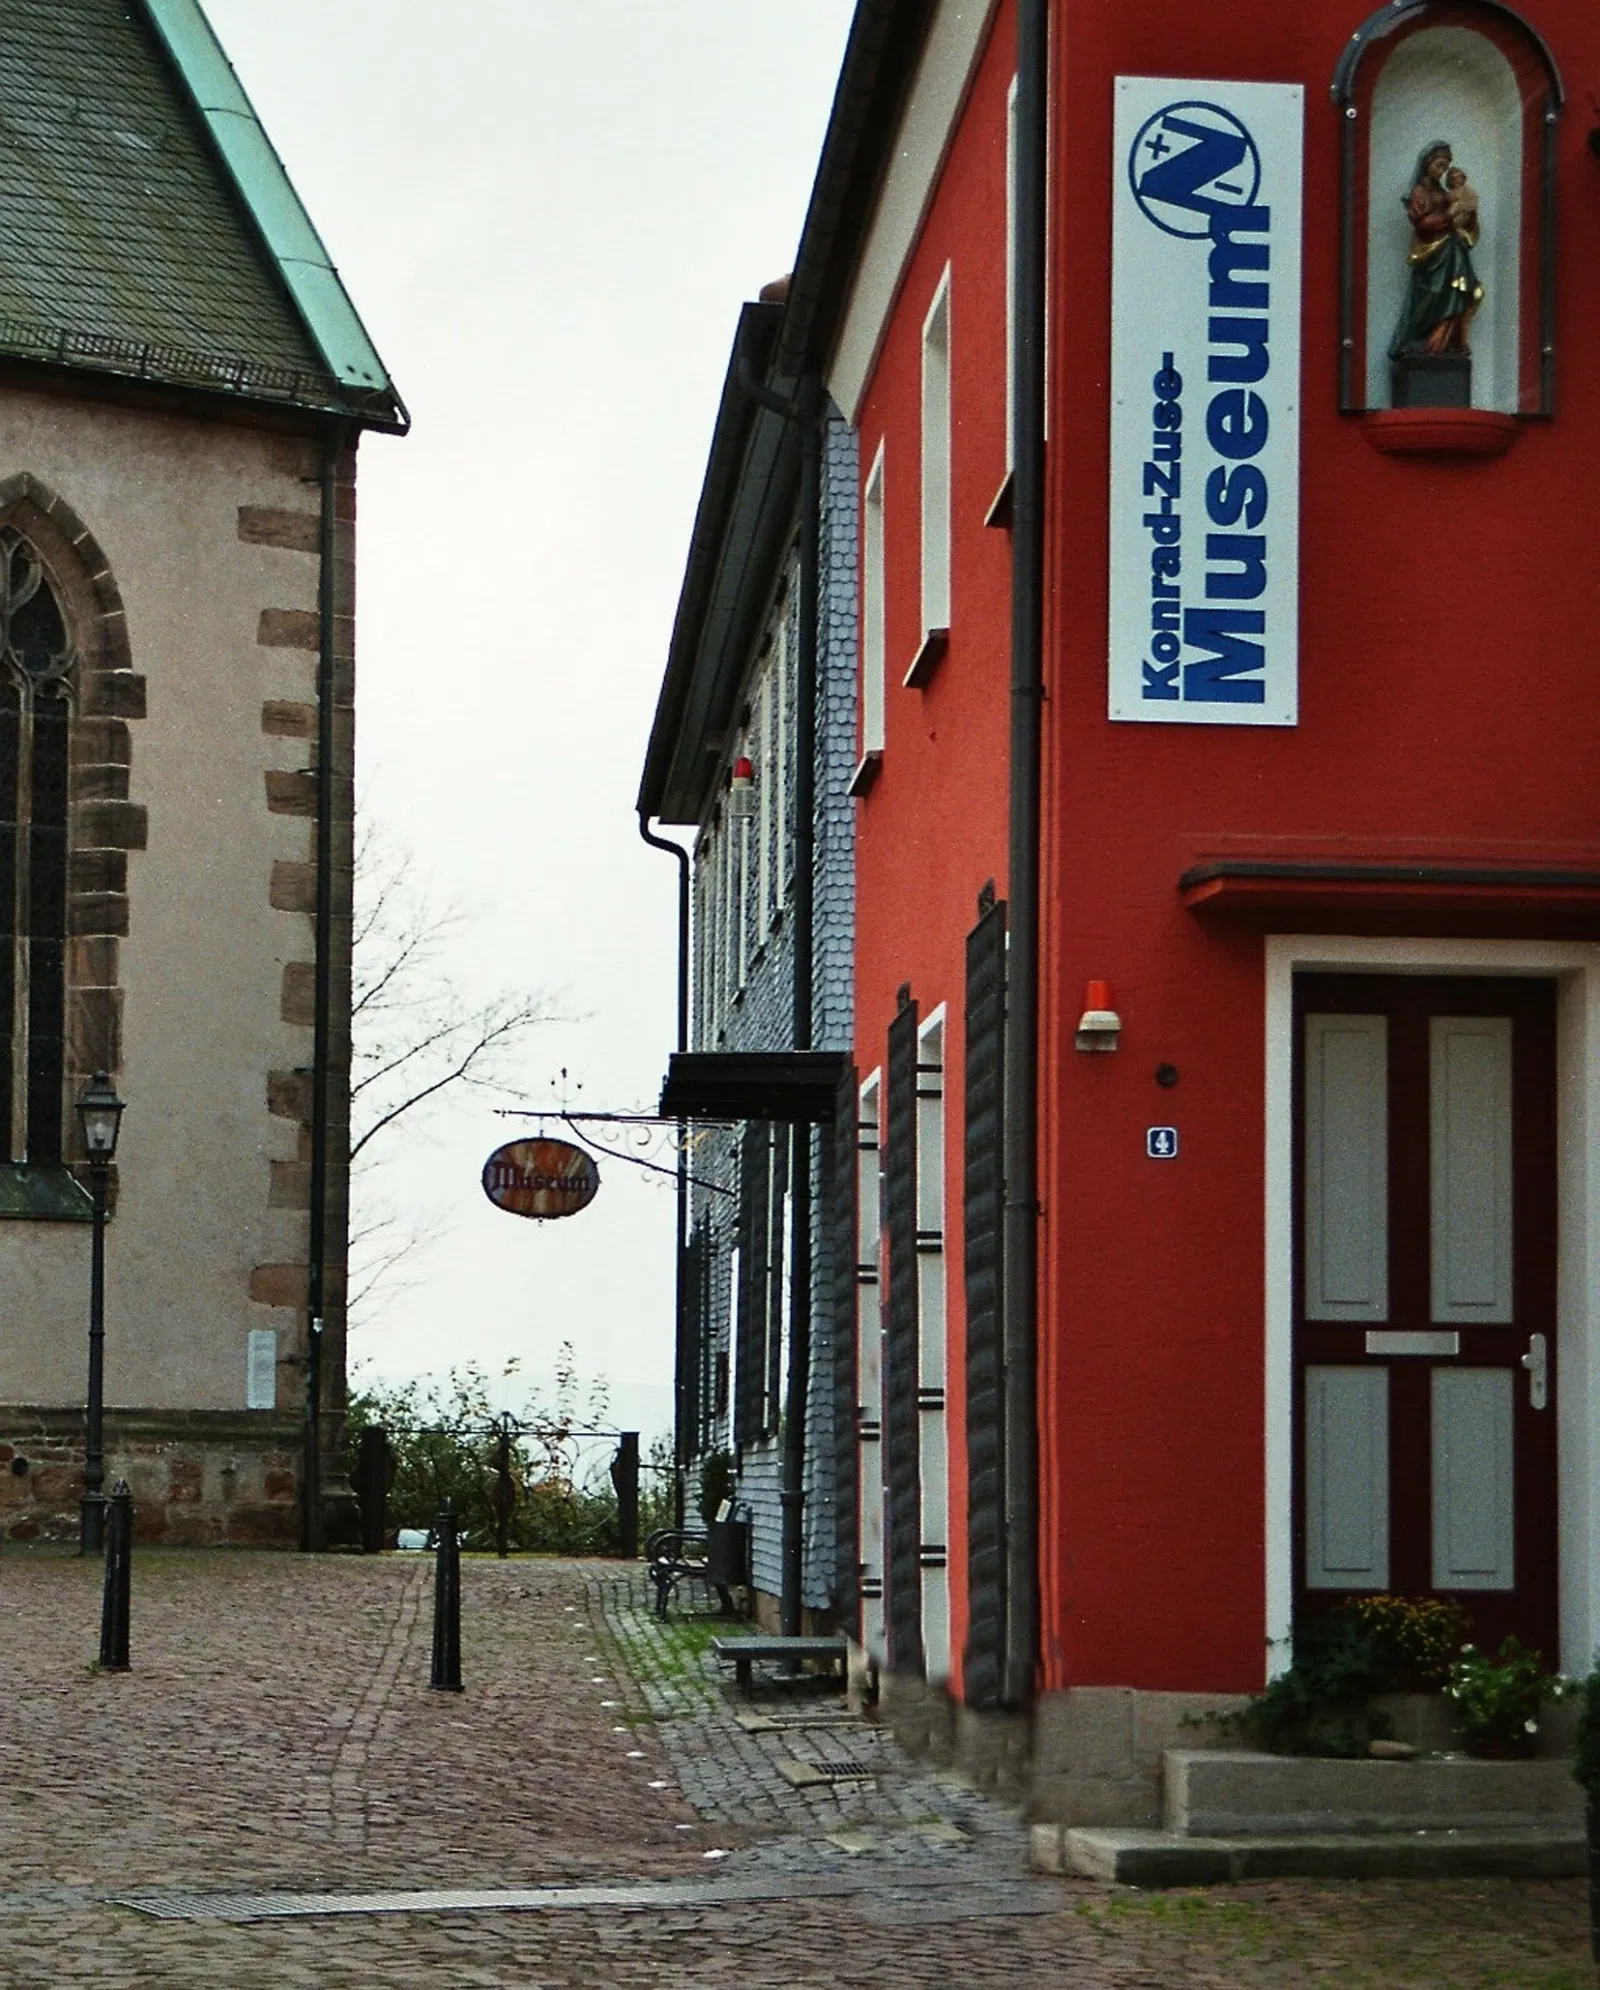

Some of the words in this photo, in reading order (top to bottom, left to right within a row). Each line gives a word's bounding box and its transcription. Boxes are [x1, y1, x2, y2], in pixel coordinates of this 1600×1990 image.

[1142, 352, 1184, 700] Konrad-Zuse-
[1183, 205, 1270, 704] Museum
[492, 1160, 589, 1192] Museum
[1155, 1131, 1170, 1153] 4
